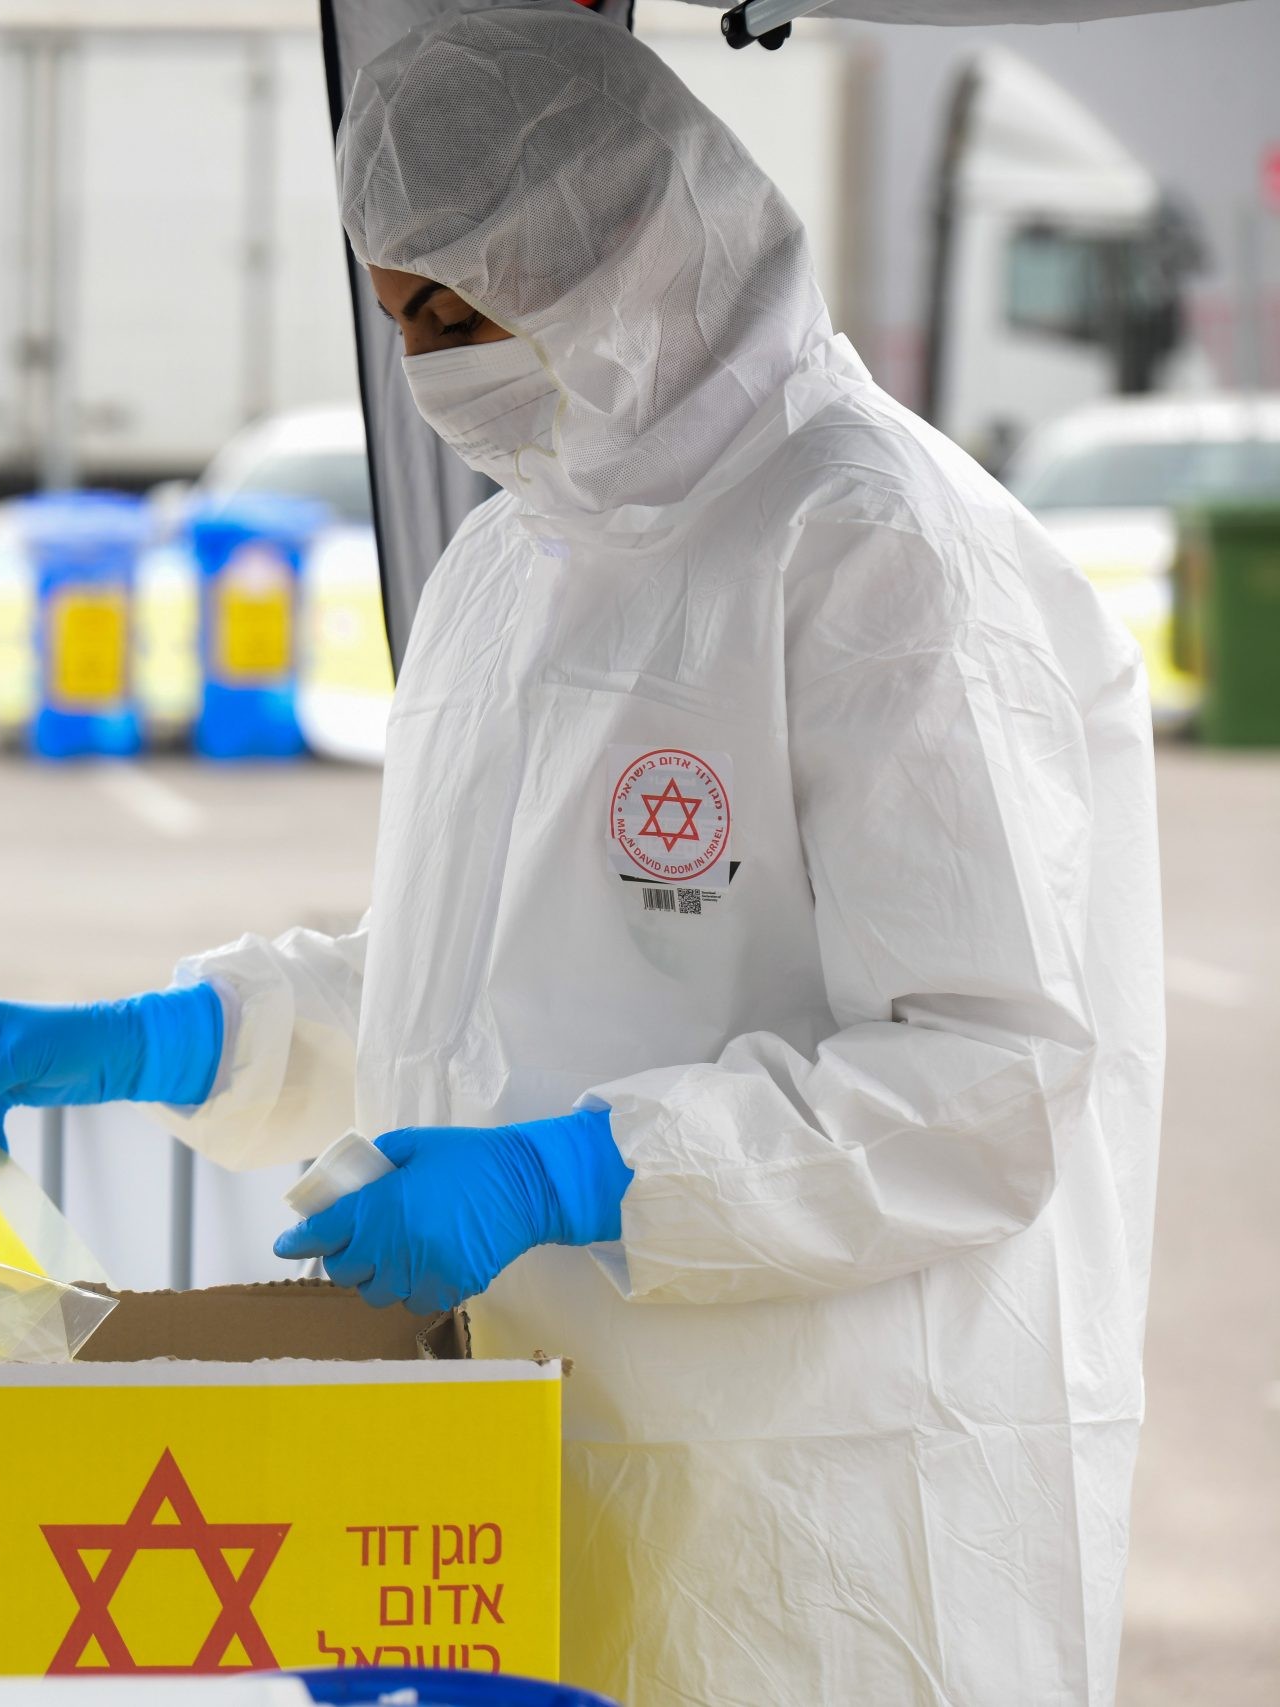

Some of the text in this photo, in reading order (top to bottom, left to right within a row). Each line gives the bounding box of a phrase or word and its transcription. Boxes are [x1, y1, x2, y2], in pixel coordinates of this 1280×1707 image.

[617, 756, 723, 810] מגן דוד אדום בישראל
[633, 847, 662, 871] DAVID
[663, 862, 694, 875] ADOM
[694, 856, 705, 869] IN
[703, 826, 724, 860] ISRAEL
[345, 1522, 503, 1580] מגן דוד
[379, 1583, 506, 1627] אדום
